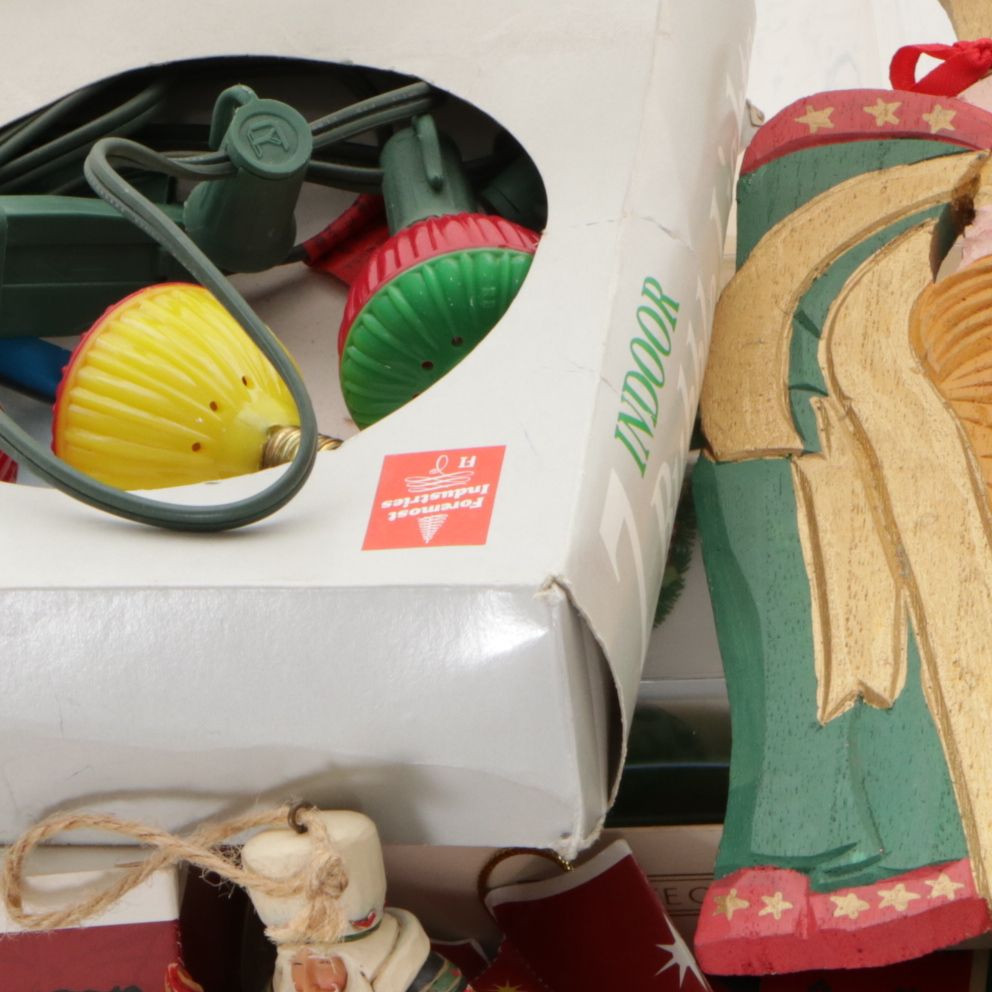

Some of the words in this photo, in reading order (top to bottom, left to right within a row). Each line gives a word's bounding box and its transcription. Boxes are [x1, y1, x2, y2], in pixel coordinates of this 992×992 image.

[614, 276, 680, 479] INDOOR
[380, 483, 491, 509] Industries
[387, 496, 485, 523] Foremost
